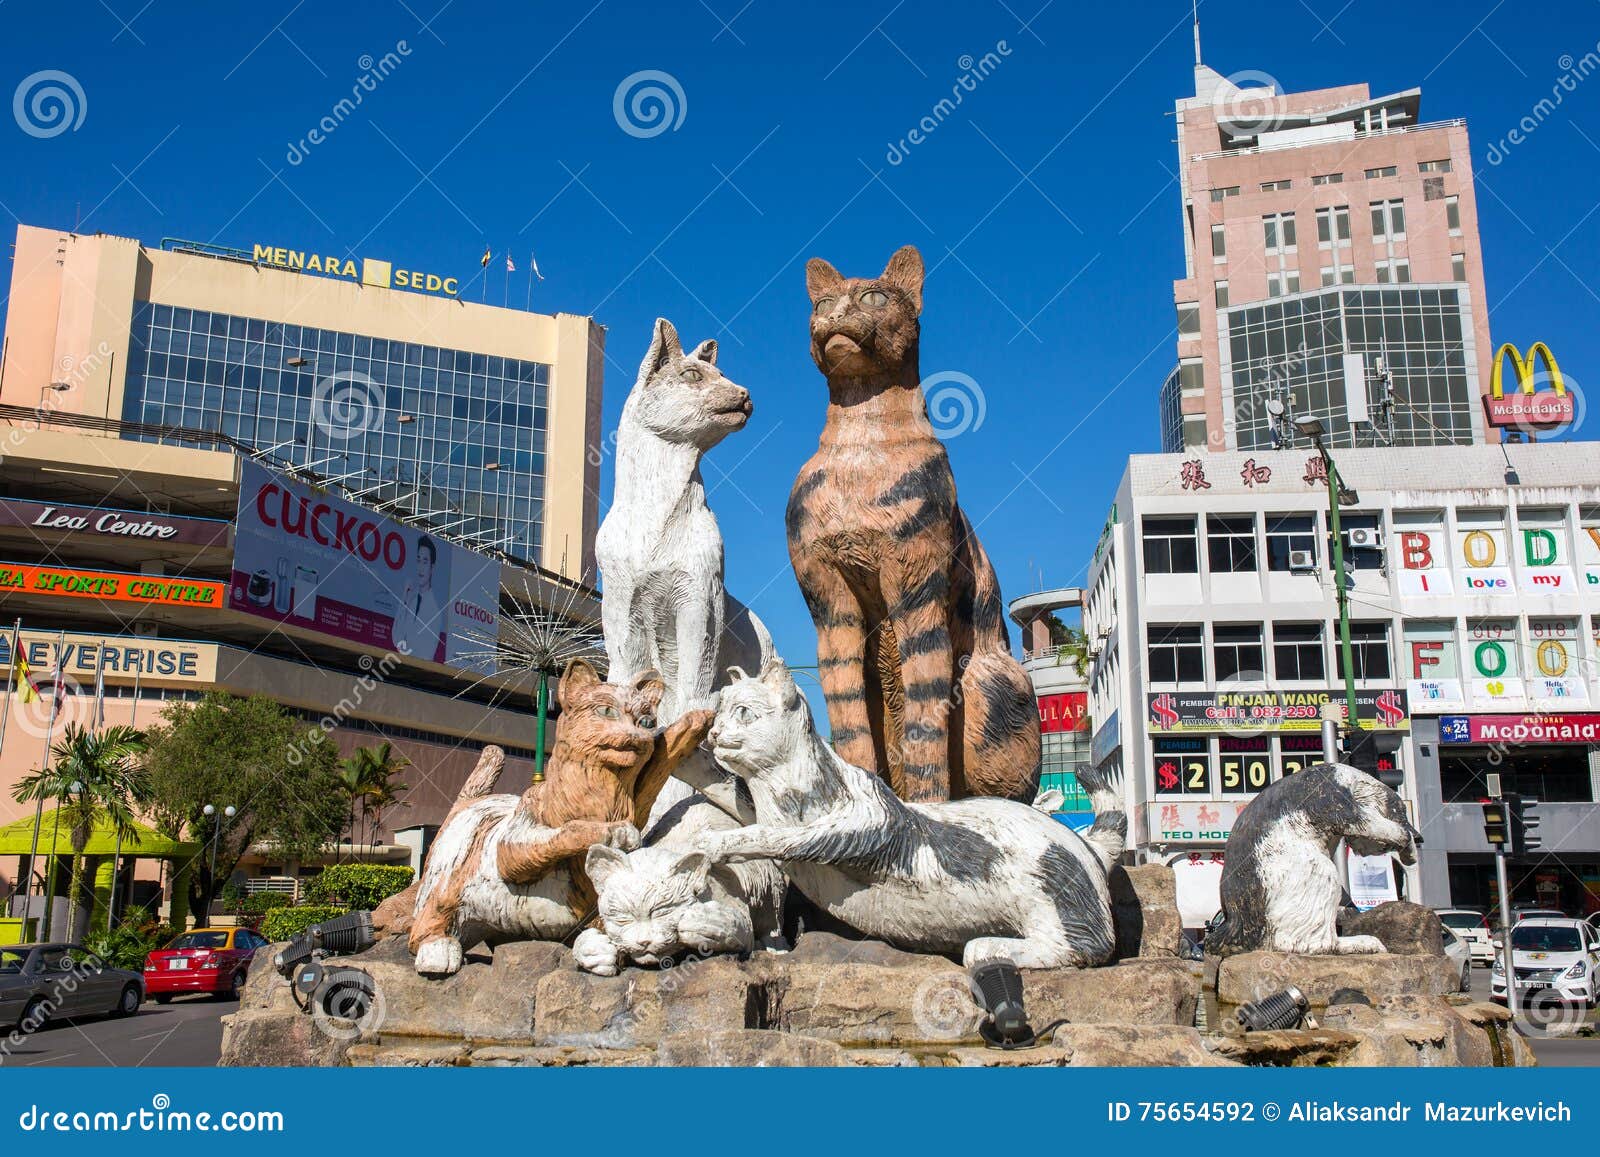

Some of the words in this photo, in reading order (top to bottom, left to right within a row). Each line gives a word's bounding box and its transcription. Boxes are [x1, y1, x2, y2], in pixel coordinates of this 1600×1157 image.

[253, 244, 358, 278] MENARA
[395, 269, 458, 295] SEDC
[1494, 403, 1571, 416] McDonald's
[32, 507, 89, 530] Lea
[95, 513, 178, 539] Centre
[256, 483, 406, 571] CUCKOO
[34, 573, 120, 596] SPORTS
[127, 579, 216, 604] CENTRE
[1466, 576, 1508, 589] love
[1533, 575, 1562, 587] my
[454, 601, 495, 625] CUCKOO
[28, 642, 199, 677] EVERRISE
[1218, 694, 1278, 706] PINJAM
[1281, 693, 1330, 705] WANG
[1205, 706, 1237, 719] Call
[1251, 706, 1317, 718] 082-250
[1453, 723, 1468, 733] 24
